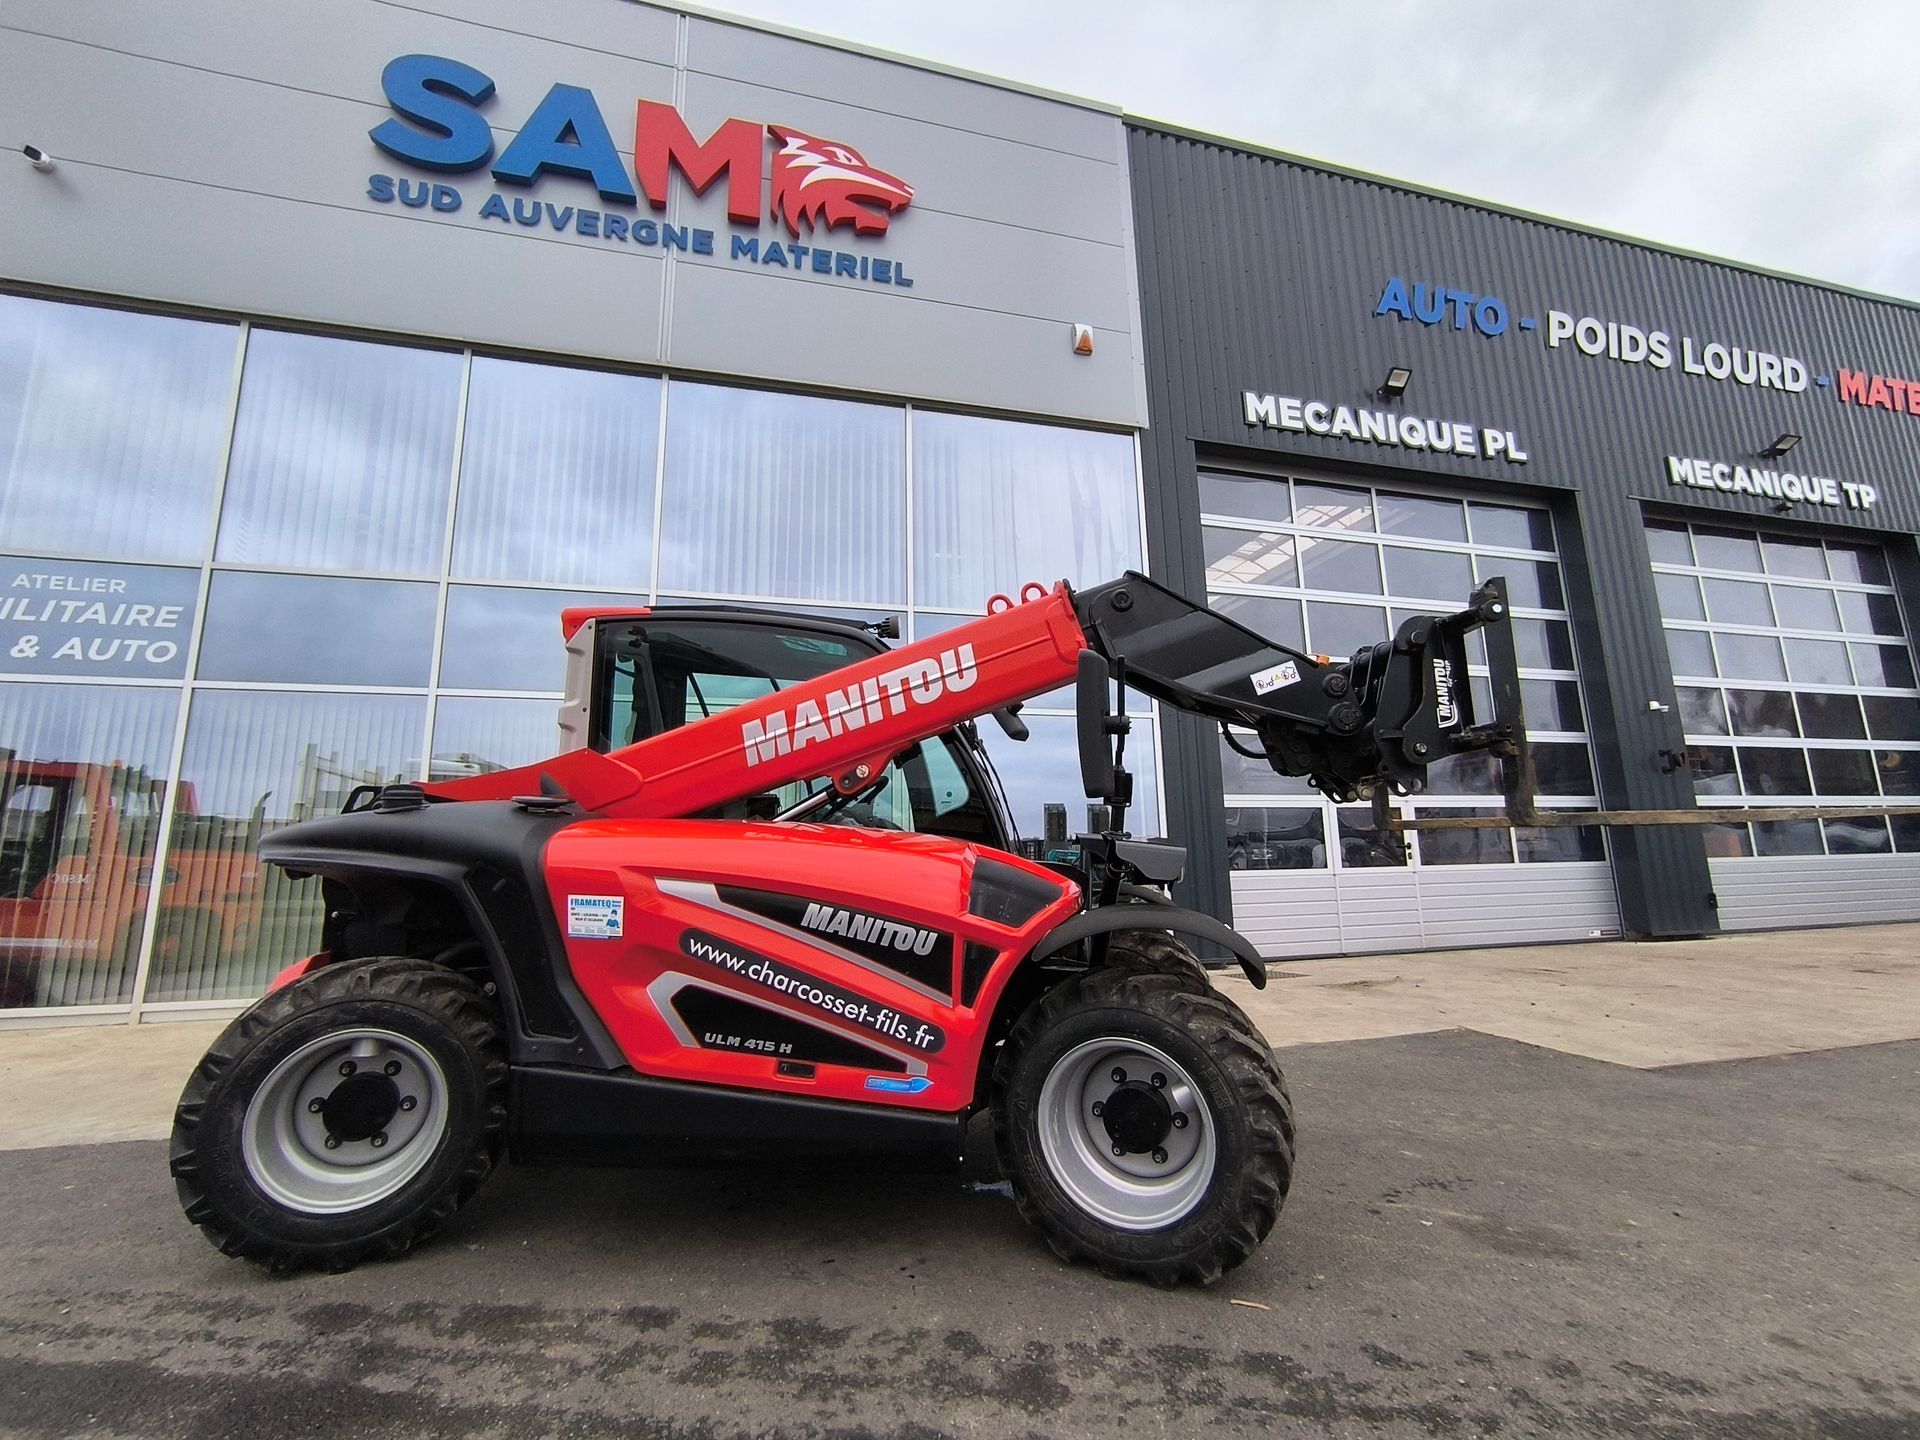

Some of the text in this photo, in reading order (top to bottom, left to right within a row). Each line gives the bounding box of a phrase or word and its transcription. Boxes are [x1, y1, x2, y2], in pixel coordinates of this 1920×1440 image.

[368, 53, 764, 226] SAM
[367, 173, 914, 286] SUD AUVERGNE MATERIEL
[1376, 277, 1508, 336] AUTO
[1548, 310, 1672, 369] POIDS
[1683, 336, 1808, 393] LOURD
[1837, 368, 1920, 417] MATE
[1243, 391, 1528, 462] MECANIQUE PL
[1667, 455, 1876, 510] MECANIQUE TP
[0, 596, 184, 628] ILITAIRE
[11, 573, 127, 594] ATELIER
[9, 634, 178, 663] & AUTO
[741, 642, 979, 768] MANITOU
[1432, 658, 1451, 717] MANITOU
[571, 898, 611, 907] FRAMATEQ
[800, 902, 938, 956] MANITOU
[689, 938, 936, 1050] www.charcosset-fils.fr
[704, 1032, 793, 1054] ULM 415 H
